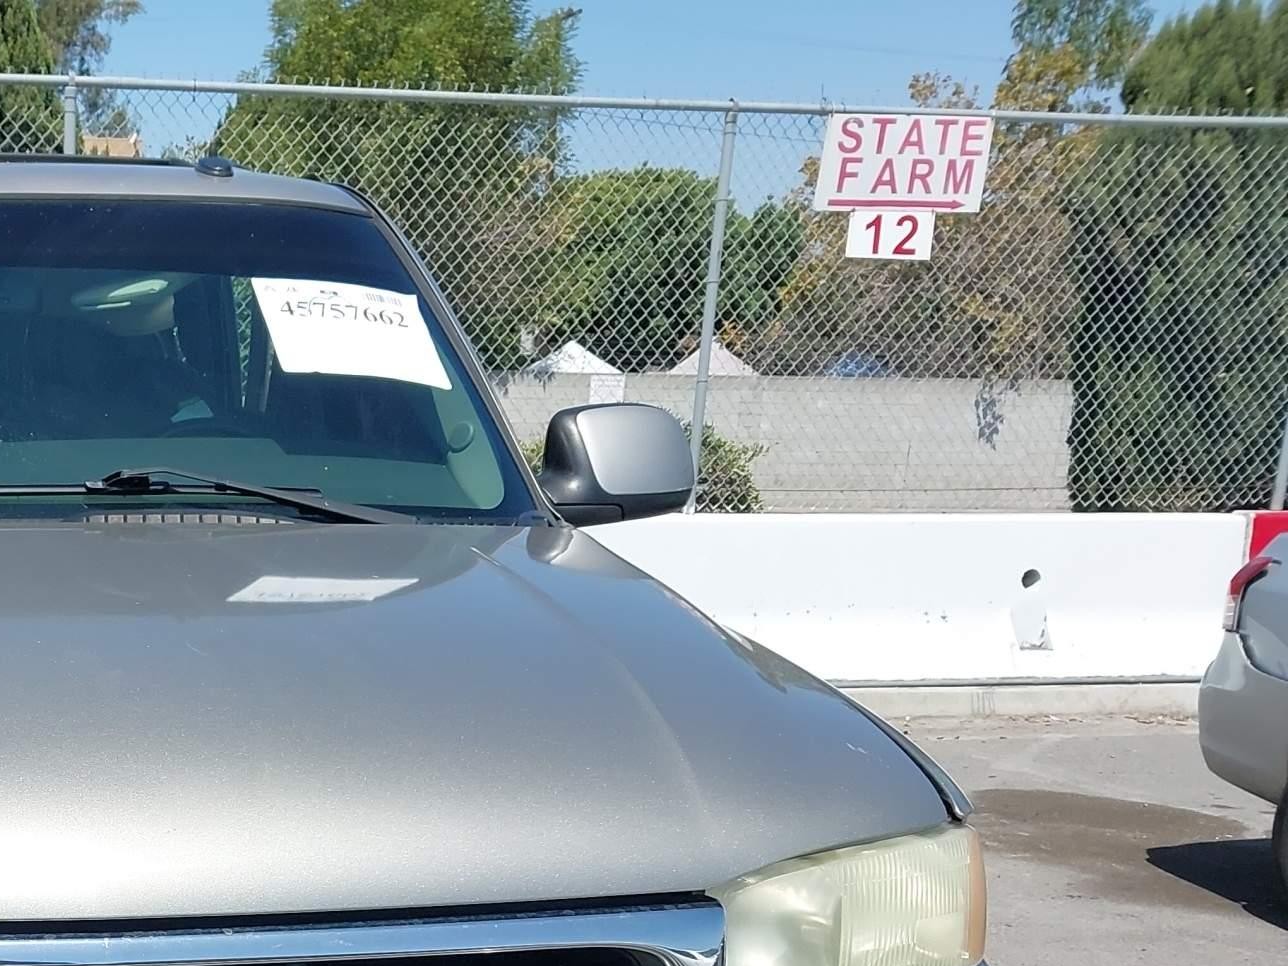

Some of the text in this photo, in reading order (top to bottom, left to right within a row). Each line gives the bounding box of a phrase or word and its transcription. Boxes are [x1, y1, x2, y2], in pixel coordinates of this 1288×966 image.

[838, 117, 987, 156] STATE
[836, 157, 975, 195] FARM
[865, 214, 919, 255] 12
[280, 300, 409, 328] 45757662
